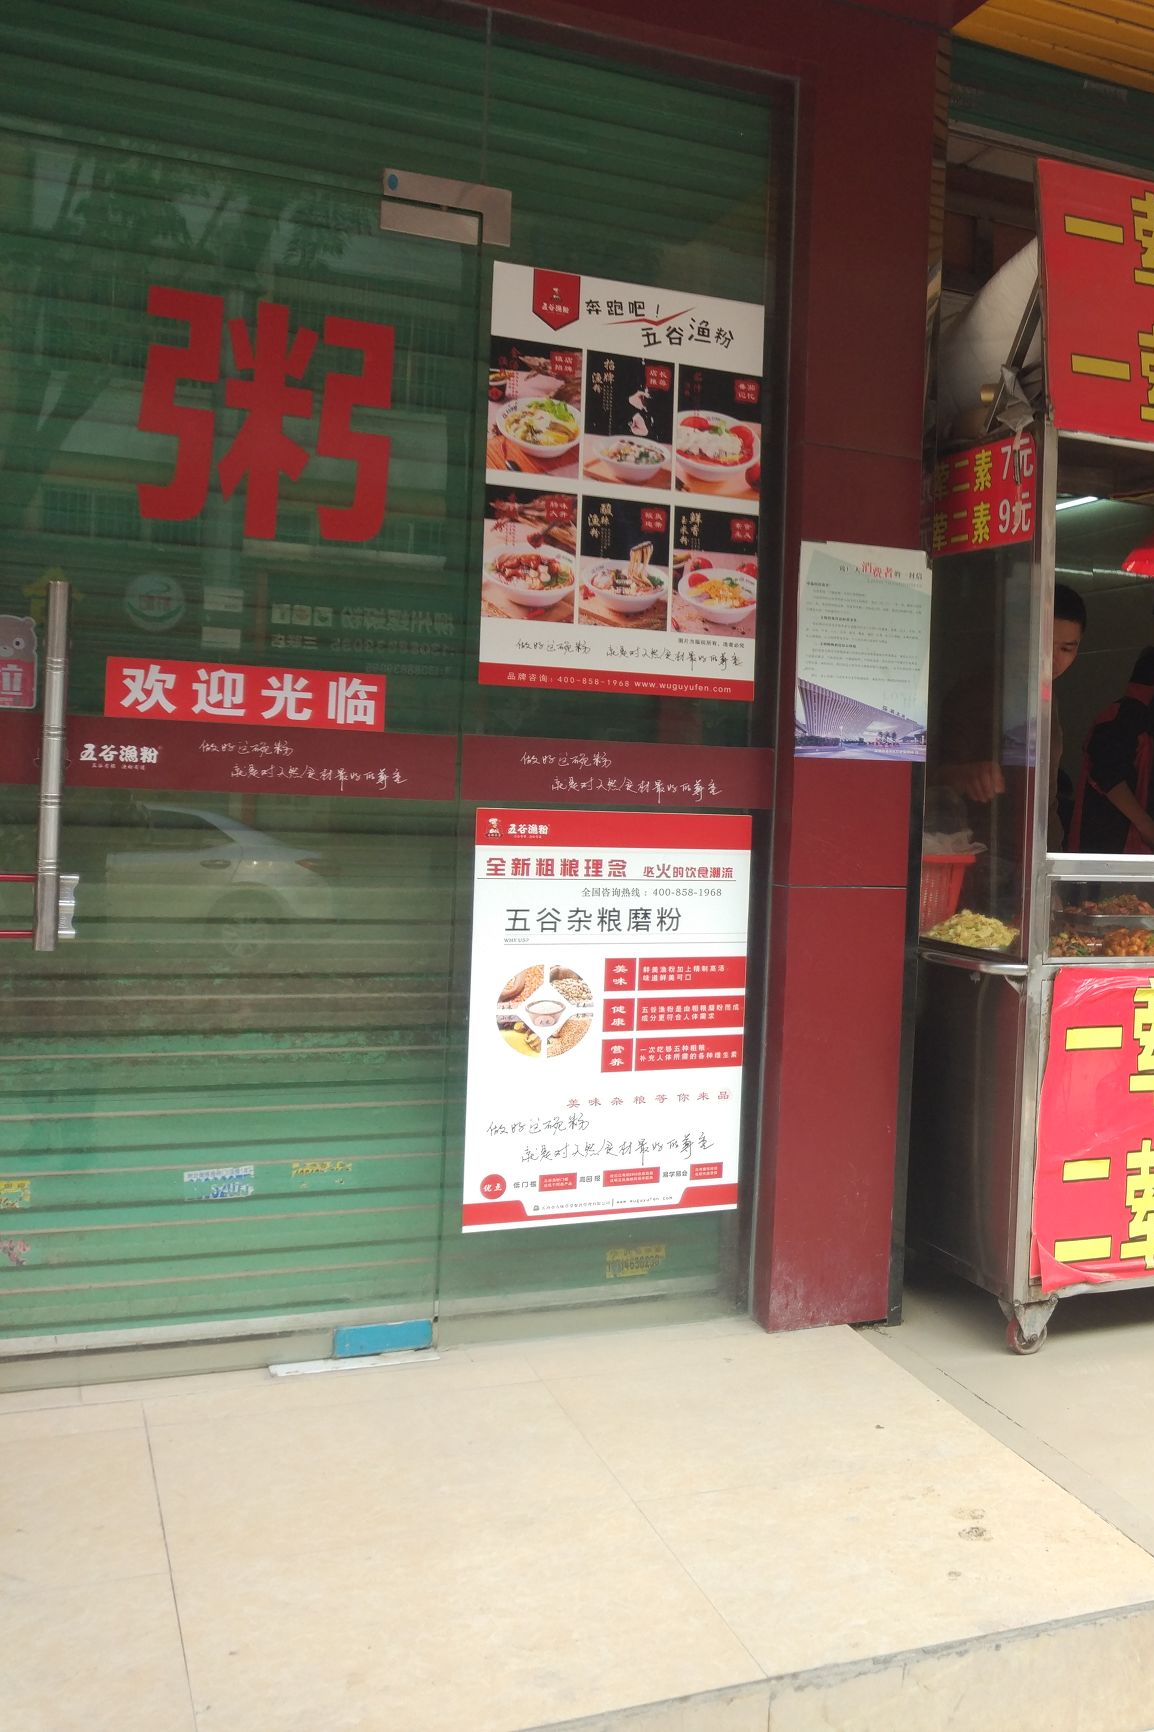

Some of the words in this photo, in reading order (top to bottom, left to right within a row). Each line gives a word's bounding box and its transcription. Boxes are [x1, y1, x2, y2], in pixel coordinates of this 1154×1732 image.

[641, 318, 735, 349] 五谷渔粉
[138, 284, 395, 542] 粥
[119, 664, 378, 725] 欢迎光临
[634, 680, 732, 694] www.wuguyufen.com
[486, 857, 628, 878] 全新粗粮理念
[643, 864, 734, 879] 必火的饮食潮流
[504, 906, 682, 933] 五谷杂粮磨粉
